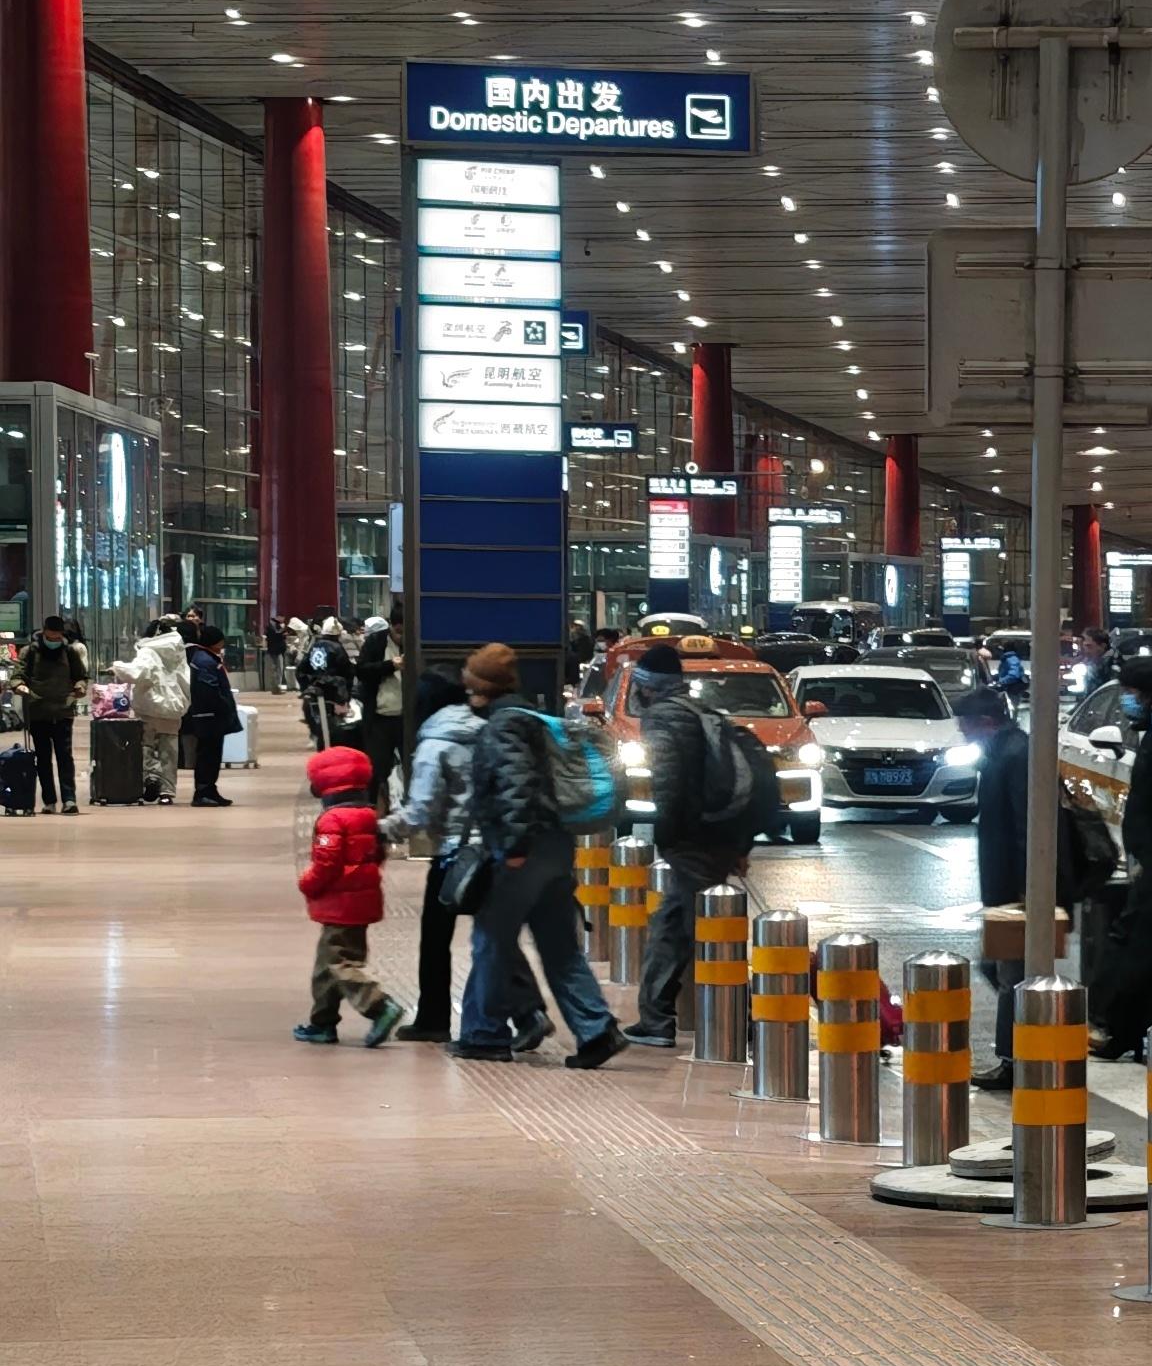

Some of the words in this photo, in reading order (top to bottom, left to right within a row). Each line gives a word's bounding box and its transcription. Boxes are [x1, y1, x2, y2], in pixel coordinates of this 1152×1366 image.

[486, 76, 622, 113] 国内出发
[430, 105, 542, 134] Domestic
[547, 111, 677, 140] Departures
[484, 366, 542, 381] 昆明航空
